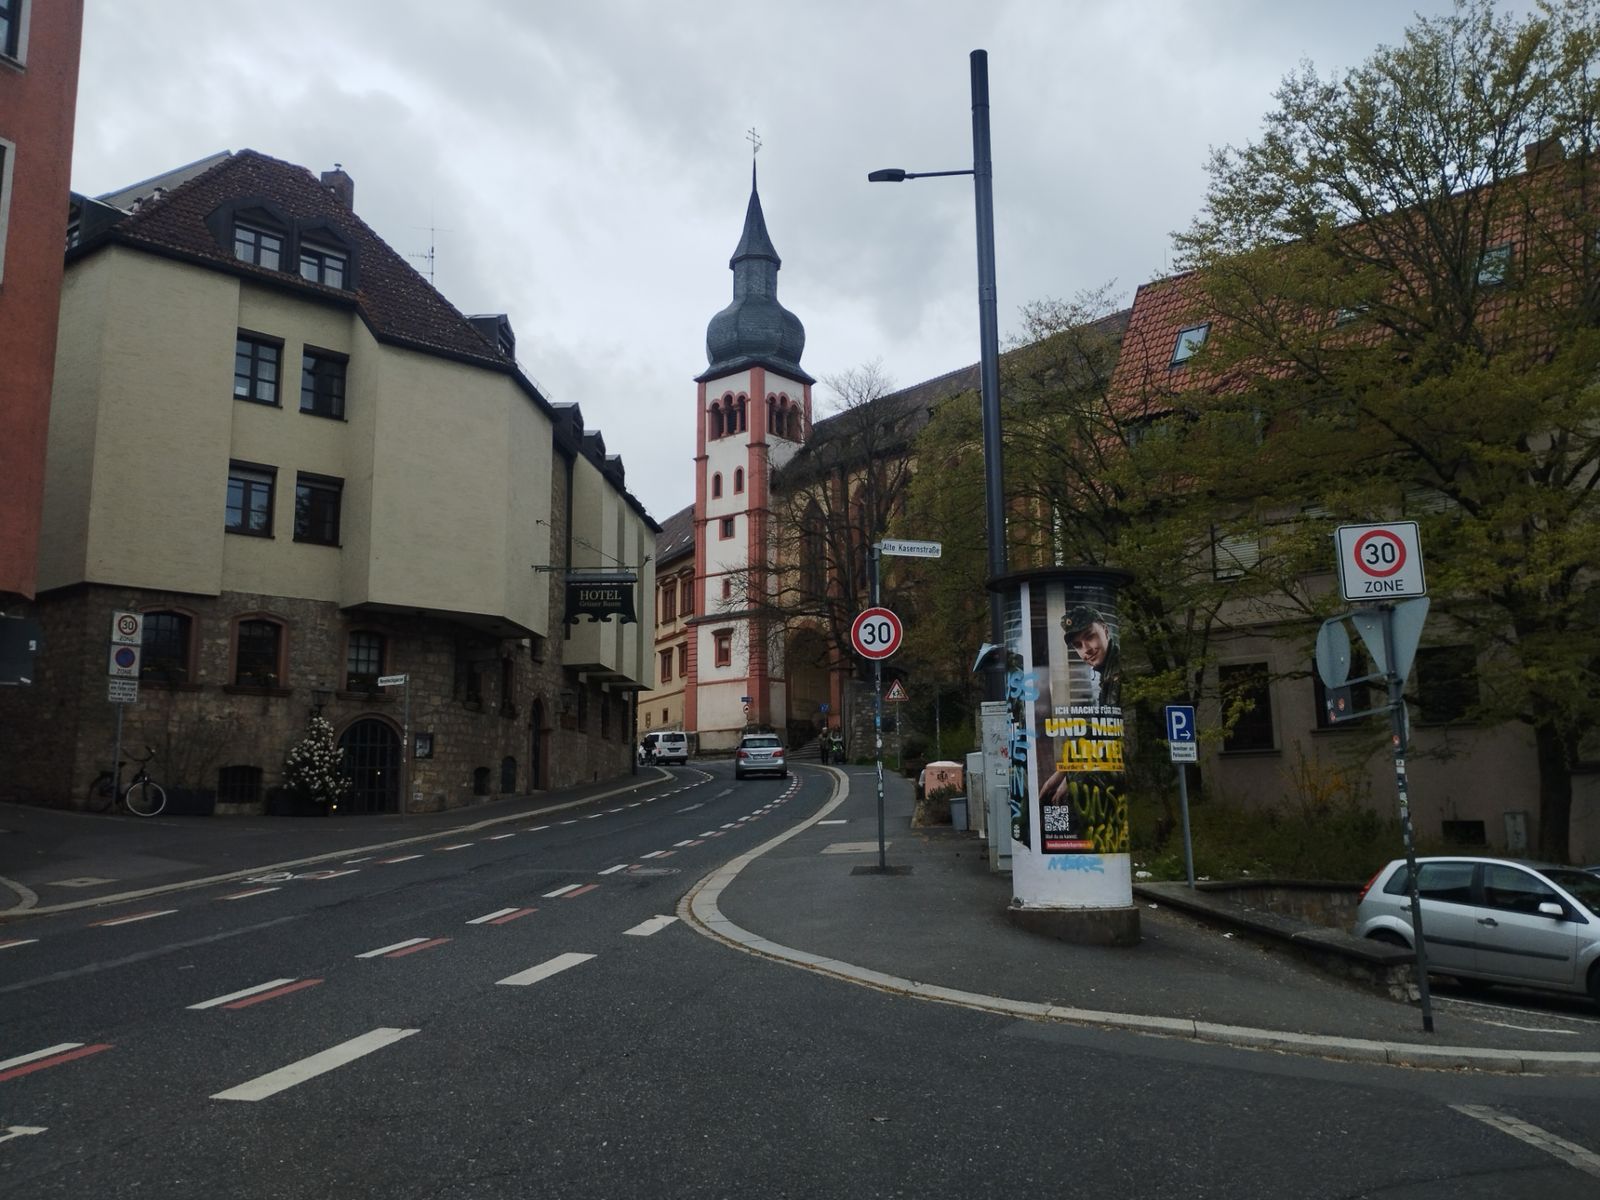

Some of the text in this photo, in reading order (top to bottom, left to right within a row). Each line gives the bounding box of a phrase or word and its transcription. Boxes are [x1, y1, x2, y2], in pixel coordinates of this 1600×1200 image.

[883, 543, 940, 554] Alte Kasernstraße
[1365, 542, 1395, 565] 30
[1364, 579, 1405, 593] ZONE
[580, 589, 622, 601] HOTEL
[121, 619, 134, 631] 30
[863, 622, 891, 645] 30
[1055, 706, 1069, 715] ICH
[1070, 706, 1100, 714] MACH'S
[1100, 704, 1112, 714] FÜR
[1045, 717, 1087, 737] UND
[1171, 710, 1187, 740] P
